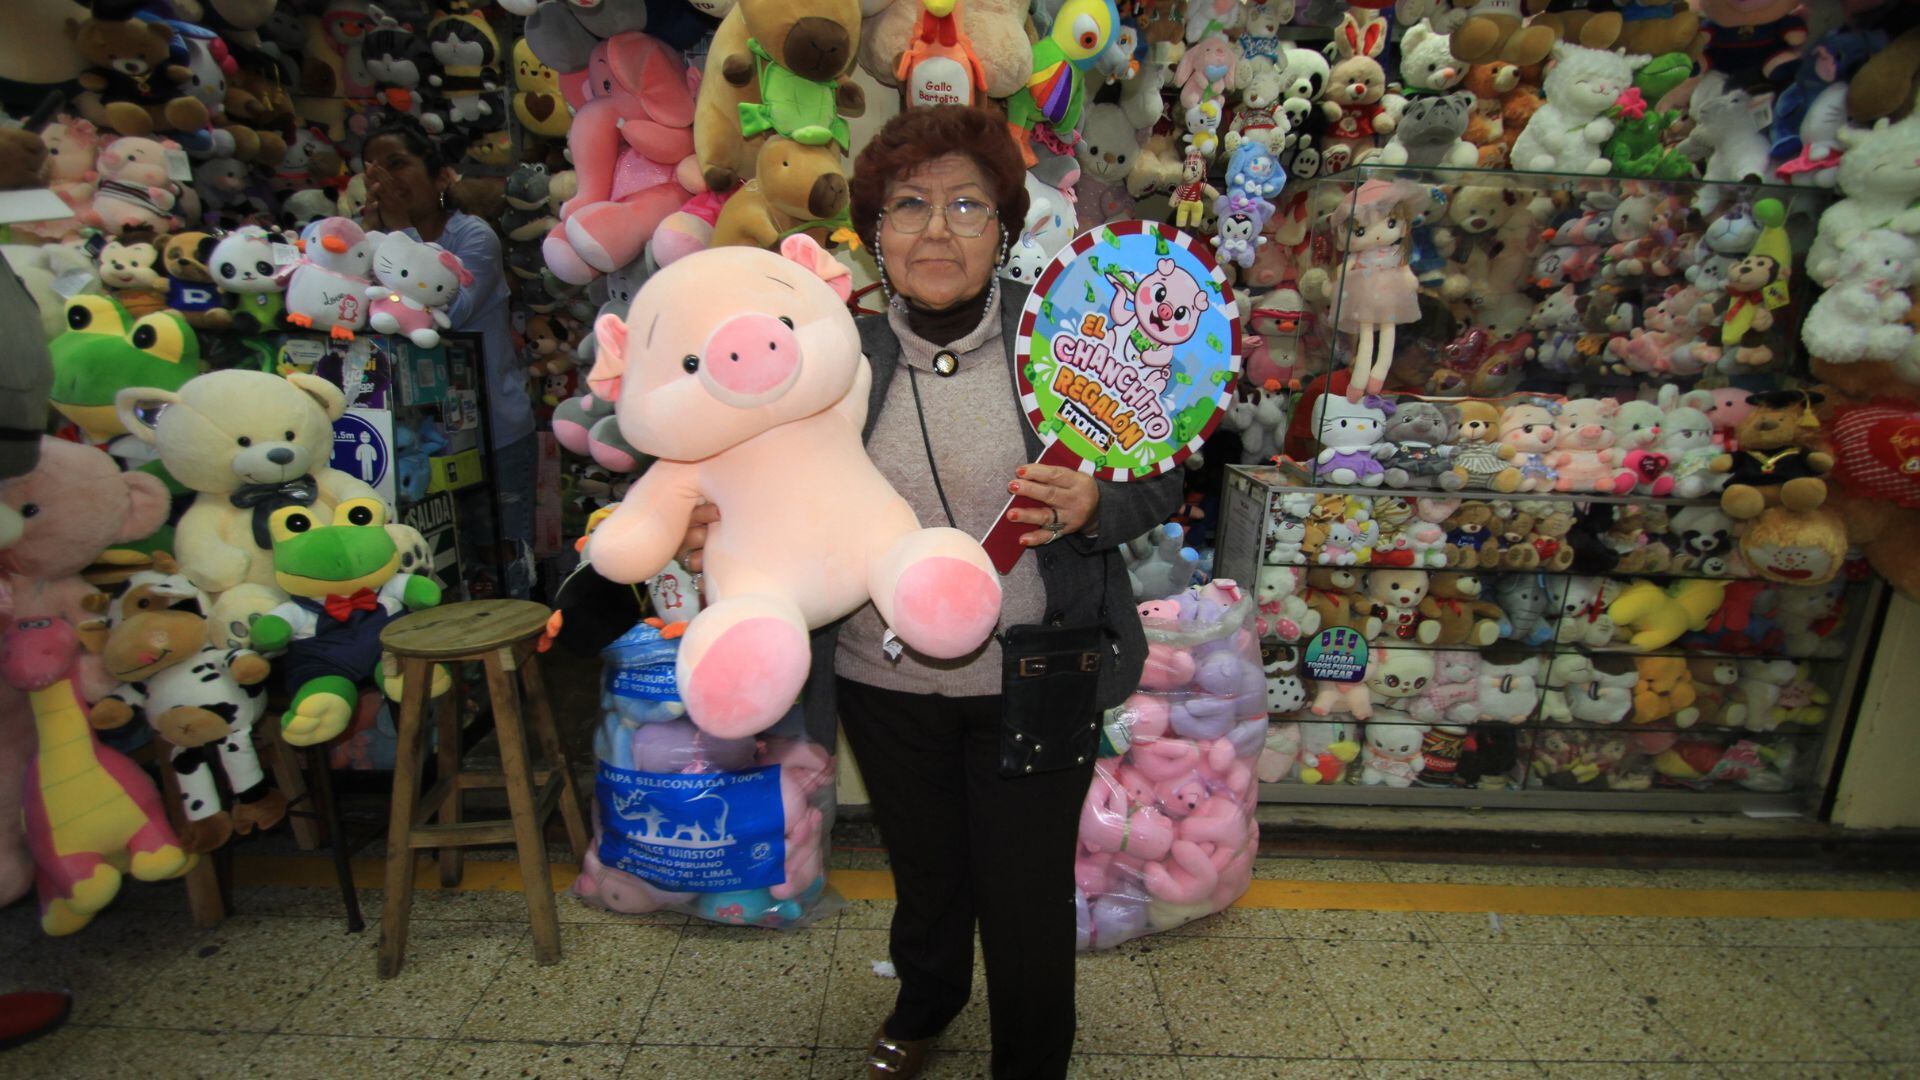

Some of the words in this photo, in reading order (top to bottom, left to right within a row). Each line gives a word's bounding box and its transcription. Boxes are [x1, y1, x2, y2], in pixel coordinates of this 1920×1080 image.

[925, 81, 952, 92] Gallo
[919, 90, 959, 103] Bartolito
[1081, 313, 1106, 340] EL
[1054, 334, 1170, 440] CHANCHITO
[1053, 365, 1145, 451] REGALÓN
[1061, 402, 1110, 446] trome
[408, 495, 452, 533] SALIDA
[1317, 654, 1354, 665] AHORA
[1307, 661, 1332, 669] TODOS
[1332, 663, 1362, 672] PUEDEN
[631, 673, 675, 685] PARURO
[1313, 668, 1353, 680] YAPEAR
[635, 776, 726, 790] SILICONADA
[731, 772, 764, 785] 100%
[674, 860, 723, 869] PERUANO
[702, 868, 734, 879] LIMA
